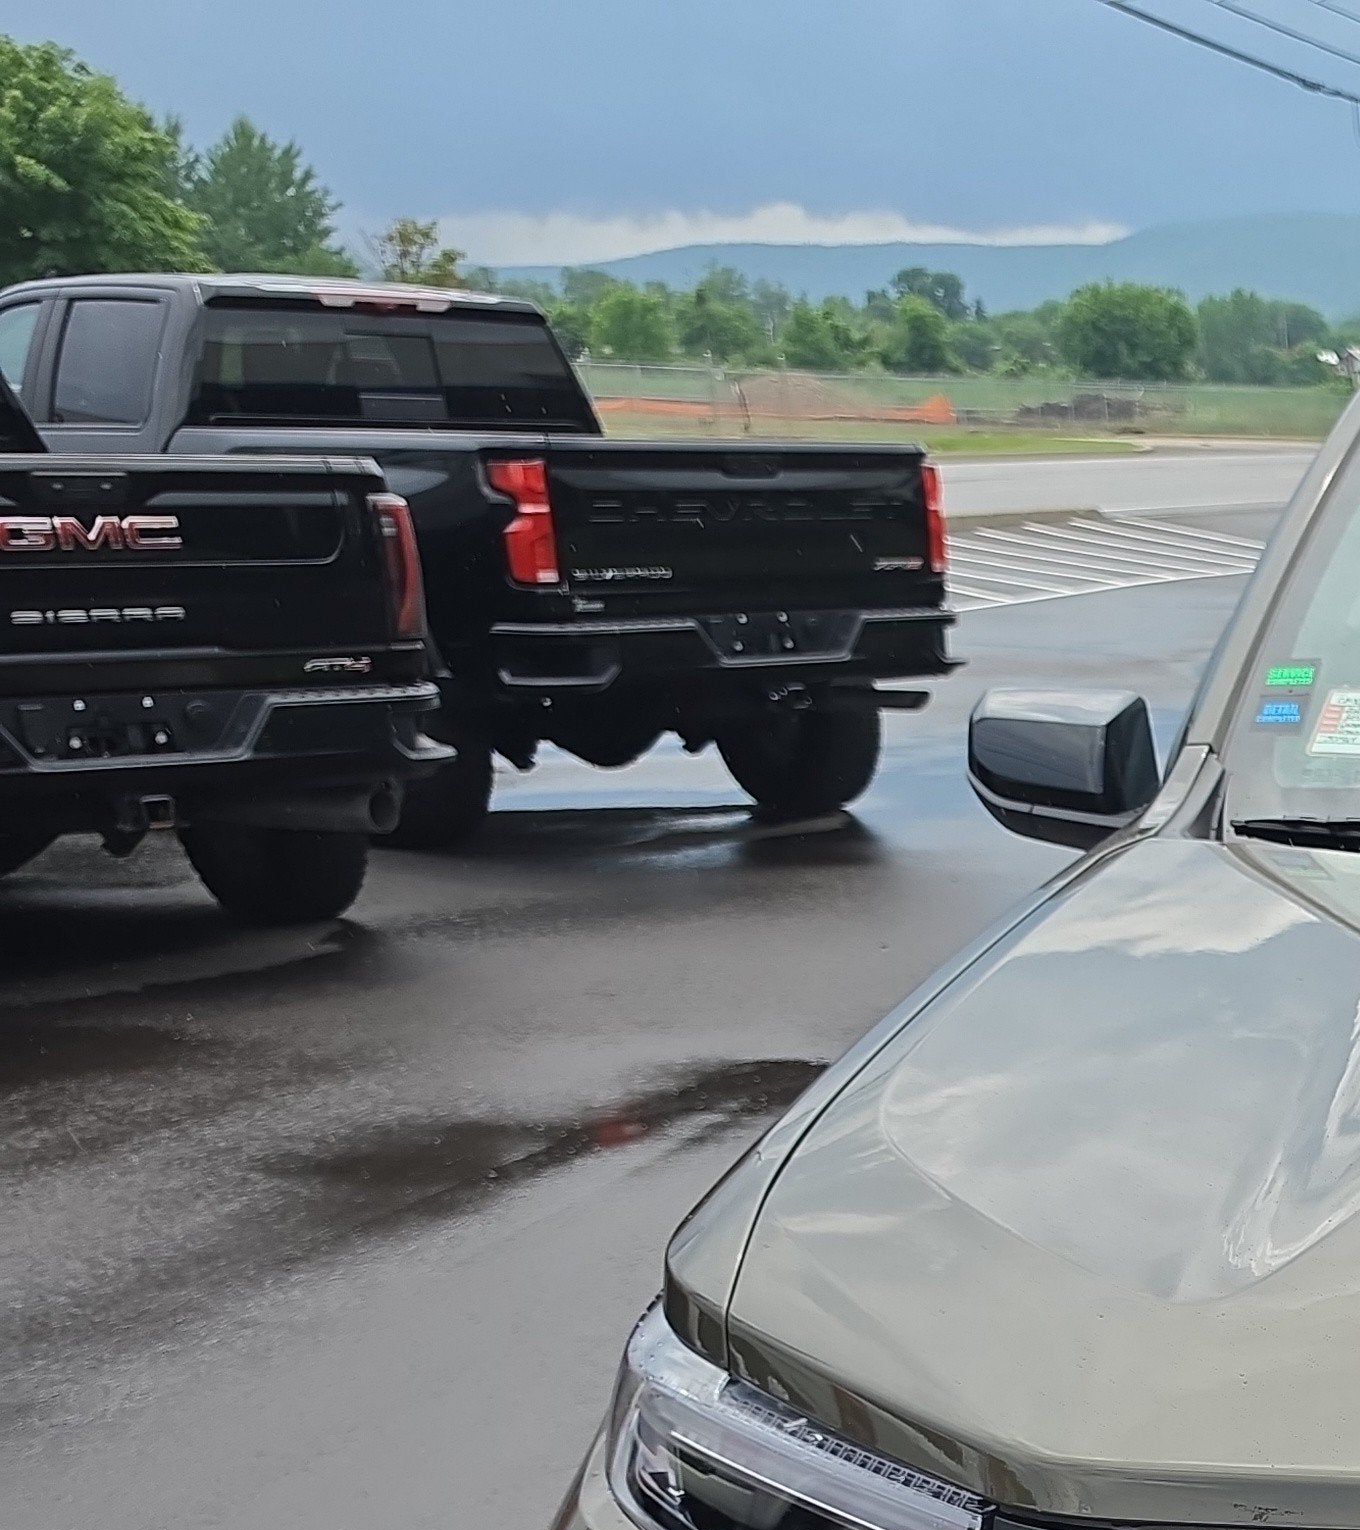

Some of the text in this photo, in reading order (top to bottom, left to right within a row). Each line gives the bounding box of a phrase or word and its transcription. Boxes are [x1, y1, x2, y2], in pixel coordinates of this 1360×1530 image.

[587, 502, 906, 523] CHEVROLET
[0, 515, 183, 551] GMC
[10, 607, 186, 625] SIERRA
